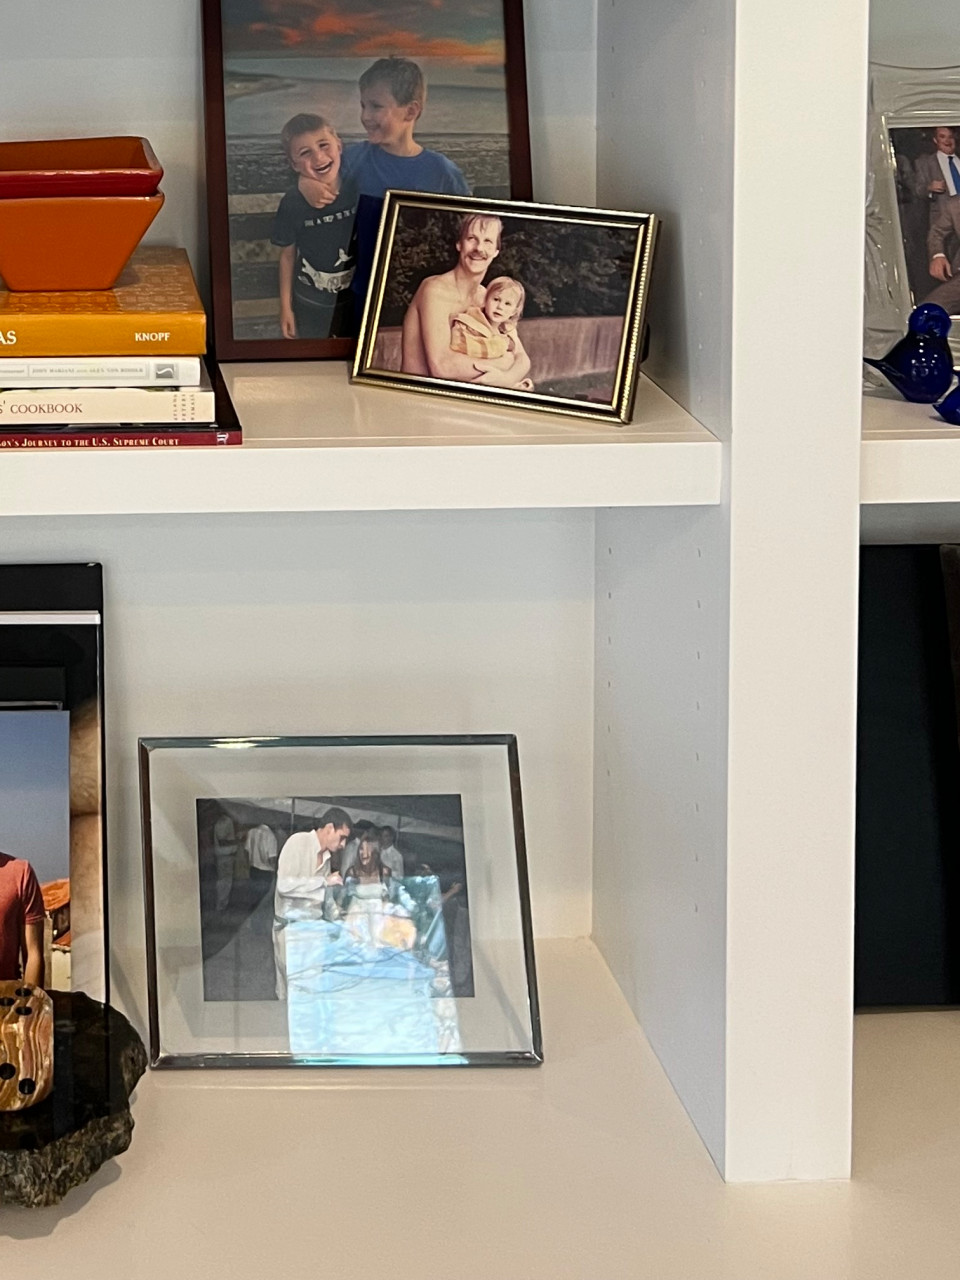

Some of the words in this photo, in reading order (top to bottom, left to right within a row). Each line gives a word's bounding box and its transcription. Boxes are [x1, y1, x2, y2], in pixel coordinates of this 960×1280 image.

[134, 331, 171, 342] KNOPF
[10, 403, 83, 414] COOKBOOK
[92, 437, 111, 447] U.S.
